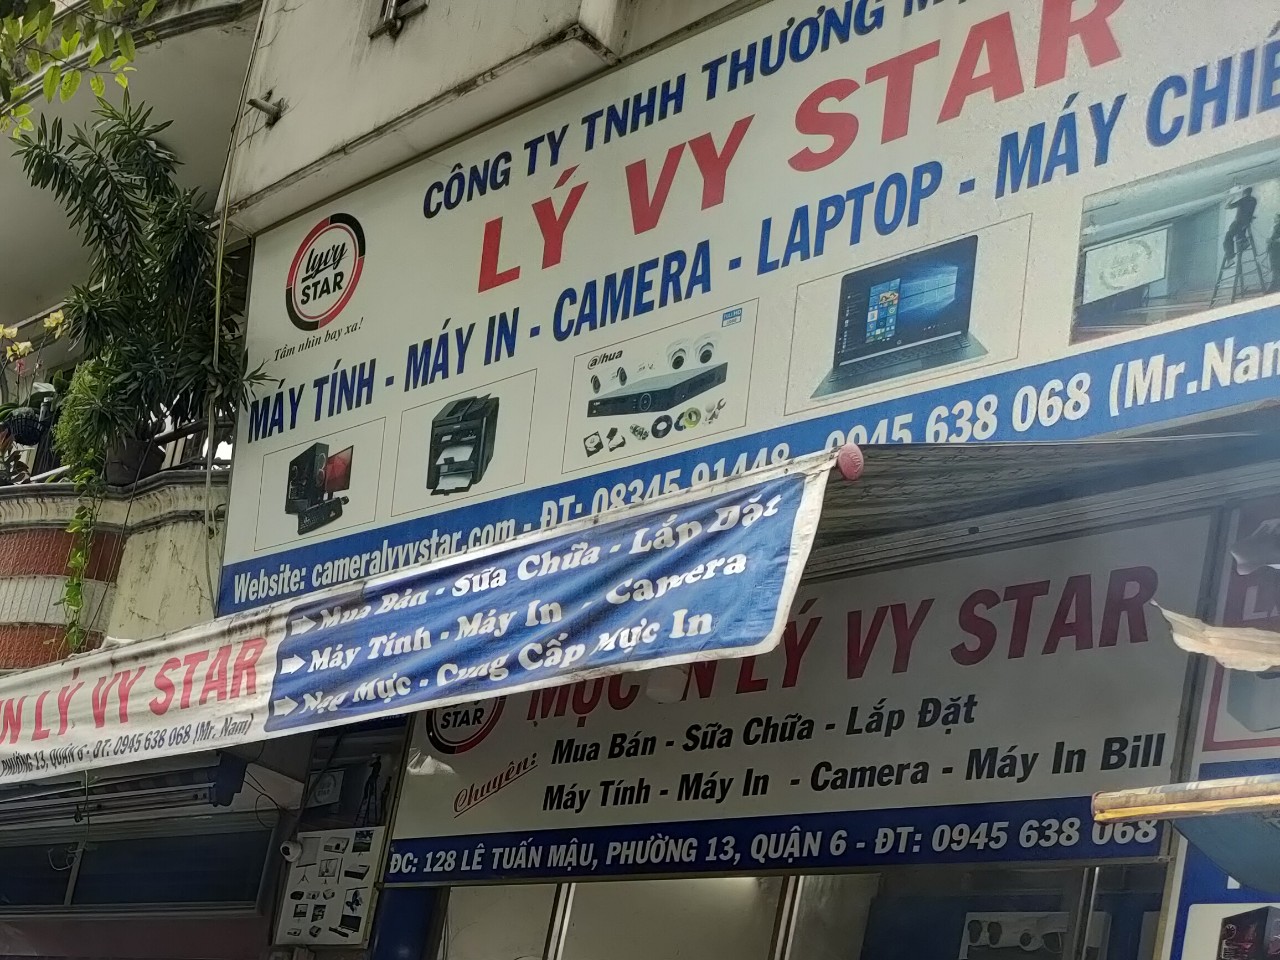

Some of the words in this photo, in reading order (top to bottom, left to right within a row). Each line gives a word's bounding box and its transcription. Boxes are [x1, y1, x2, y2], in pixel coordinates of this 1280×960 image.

[422, 151, 512, 219] CÔNG
[525, 124, 570, 176] TY
[581, 73, 686, 152] TNHH
[701, 0, 884, 100] THƯƠNG
[478, 164, 588, 293] LÝ
[624, 114, 755, 236] VY
[788, 0, 1121, 173] STAR
[247, 370, 307, 443] MÁY
[311, 357, 376, 418] TÍNH
[404, 319, 481, 393] MÁY
[483, 307, 519, 367] IN
[553, 239, 712, 343] CAMERA
[756, 160, 943, 277] LAPTOP
[995, 91, 1127, 199] MÁY
[301, 271, 344, 305] STAR
[324, 326, 343, 343] bay
[234, 564, 306, 604] Website:
[1012, 372, 1091, 432] 068
[451, 566, 508, 597] Sữa
[517, 542, 601, 581] Chữa
[629, 513, 703, 556] Lắp
[307, 643, 361, 672] Máy
[367, 626, 432, 660] Tính
[454, 609, 517, 641] Máy
[525, 599, 563, 627] In
[606, 553, 747, 605] Camera
[353, 672, 411, 704] Mực
[518, 632, 586, 672] Cấp
[669, 608, 713, 639] In
[846, 597, 935, 681] VY
[951, 565, 1158, 666] STAR
[31, 667, 84, 741] LÝ
[92, 666, 146, 728] VY
[149, 637, 267, 716] STAR
[440, 707, 485, 730] STAR
[551, 738, 600, 765] Mua
[608, 730, 656, 759] Bán
[682, 722, 733, 752] Sữa
[742, 713, 815, 746] Chữa
[846, 702, 906, 737] Lắp
[916, 693, 978, 735] Đặt
[113, 732, 143, 756] 0945
[144, 728, 165, 751] 638
[168, 724, 191, 746] 068
[219, 713, 255, 738] Nam)
[542, 784, 590, 814] Máy
[599, 778, 651, 806] Tính
[677, 771, 732, 803] Máy
[742, 768, 770, 796] In
[810, 754, 928, 792] Camera
[965, 745, 1039, 782] Máy
[1053, 741, 1086, 775] In
[1100, 733, 1166, 771] Bill
[389, 854, 418, 874] ĐC:
[423, 851, 457, 873] 128
[460, 847, 485, 871] LÊ
[492, 838, 543, 870] TUẤN
[547, 838, 598, 872] MẬU,
[605, 834, 698, 866] PHƯỜNG
[705, 835, 741, 865] 13,
[750, 826, 822, 863] QUẬN
[829, 829, 848, 856] 6
[874, 826, 922, 855] ĐT:
[931, 820, 1010, 852] 0945
[1019, 817, 1081, 849] 638
[1091, 818, 1159, 845] 068
